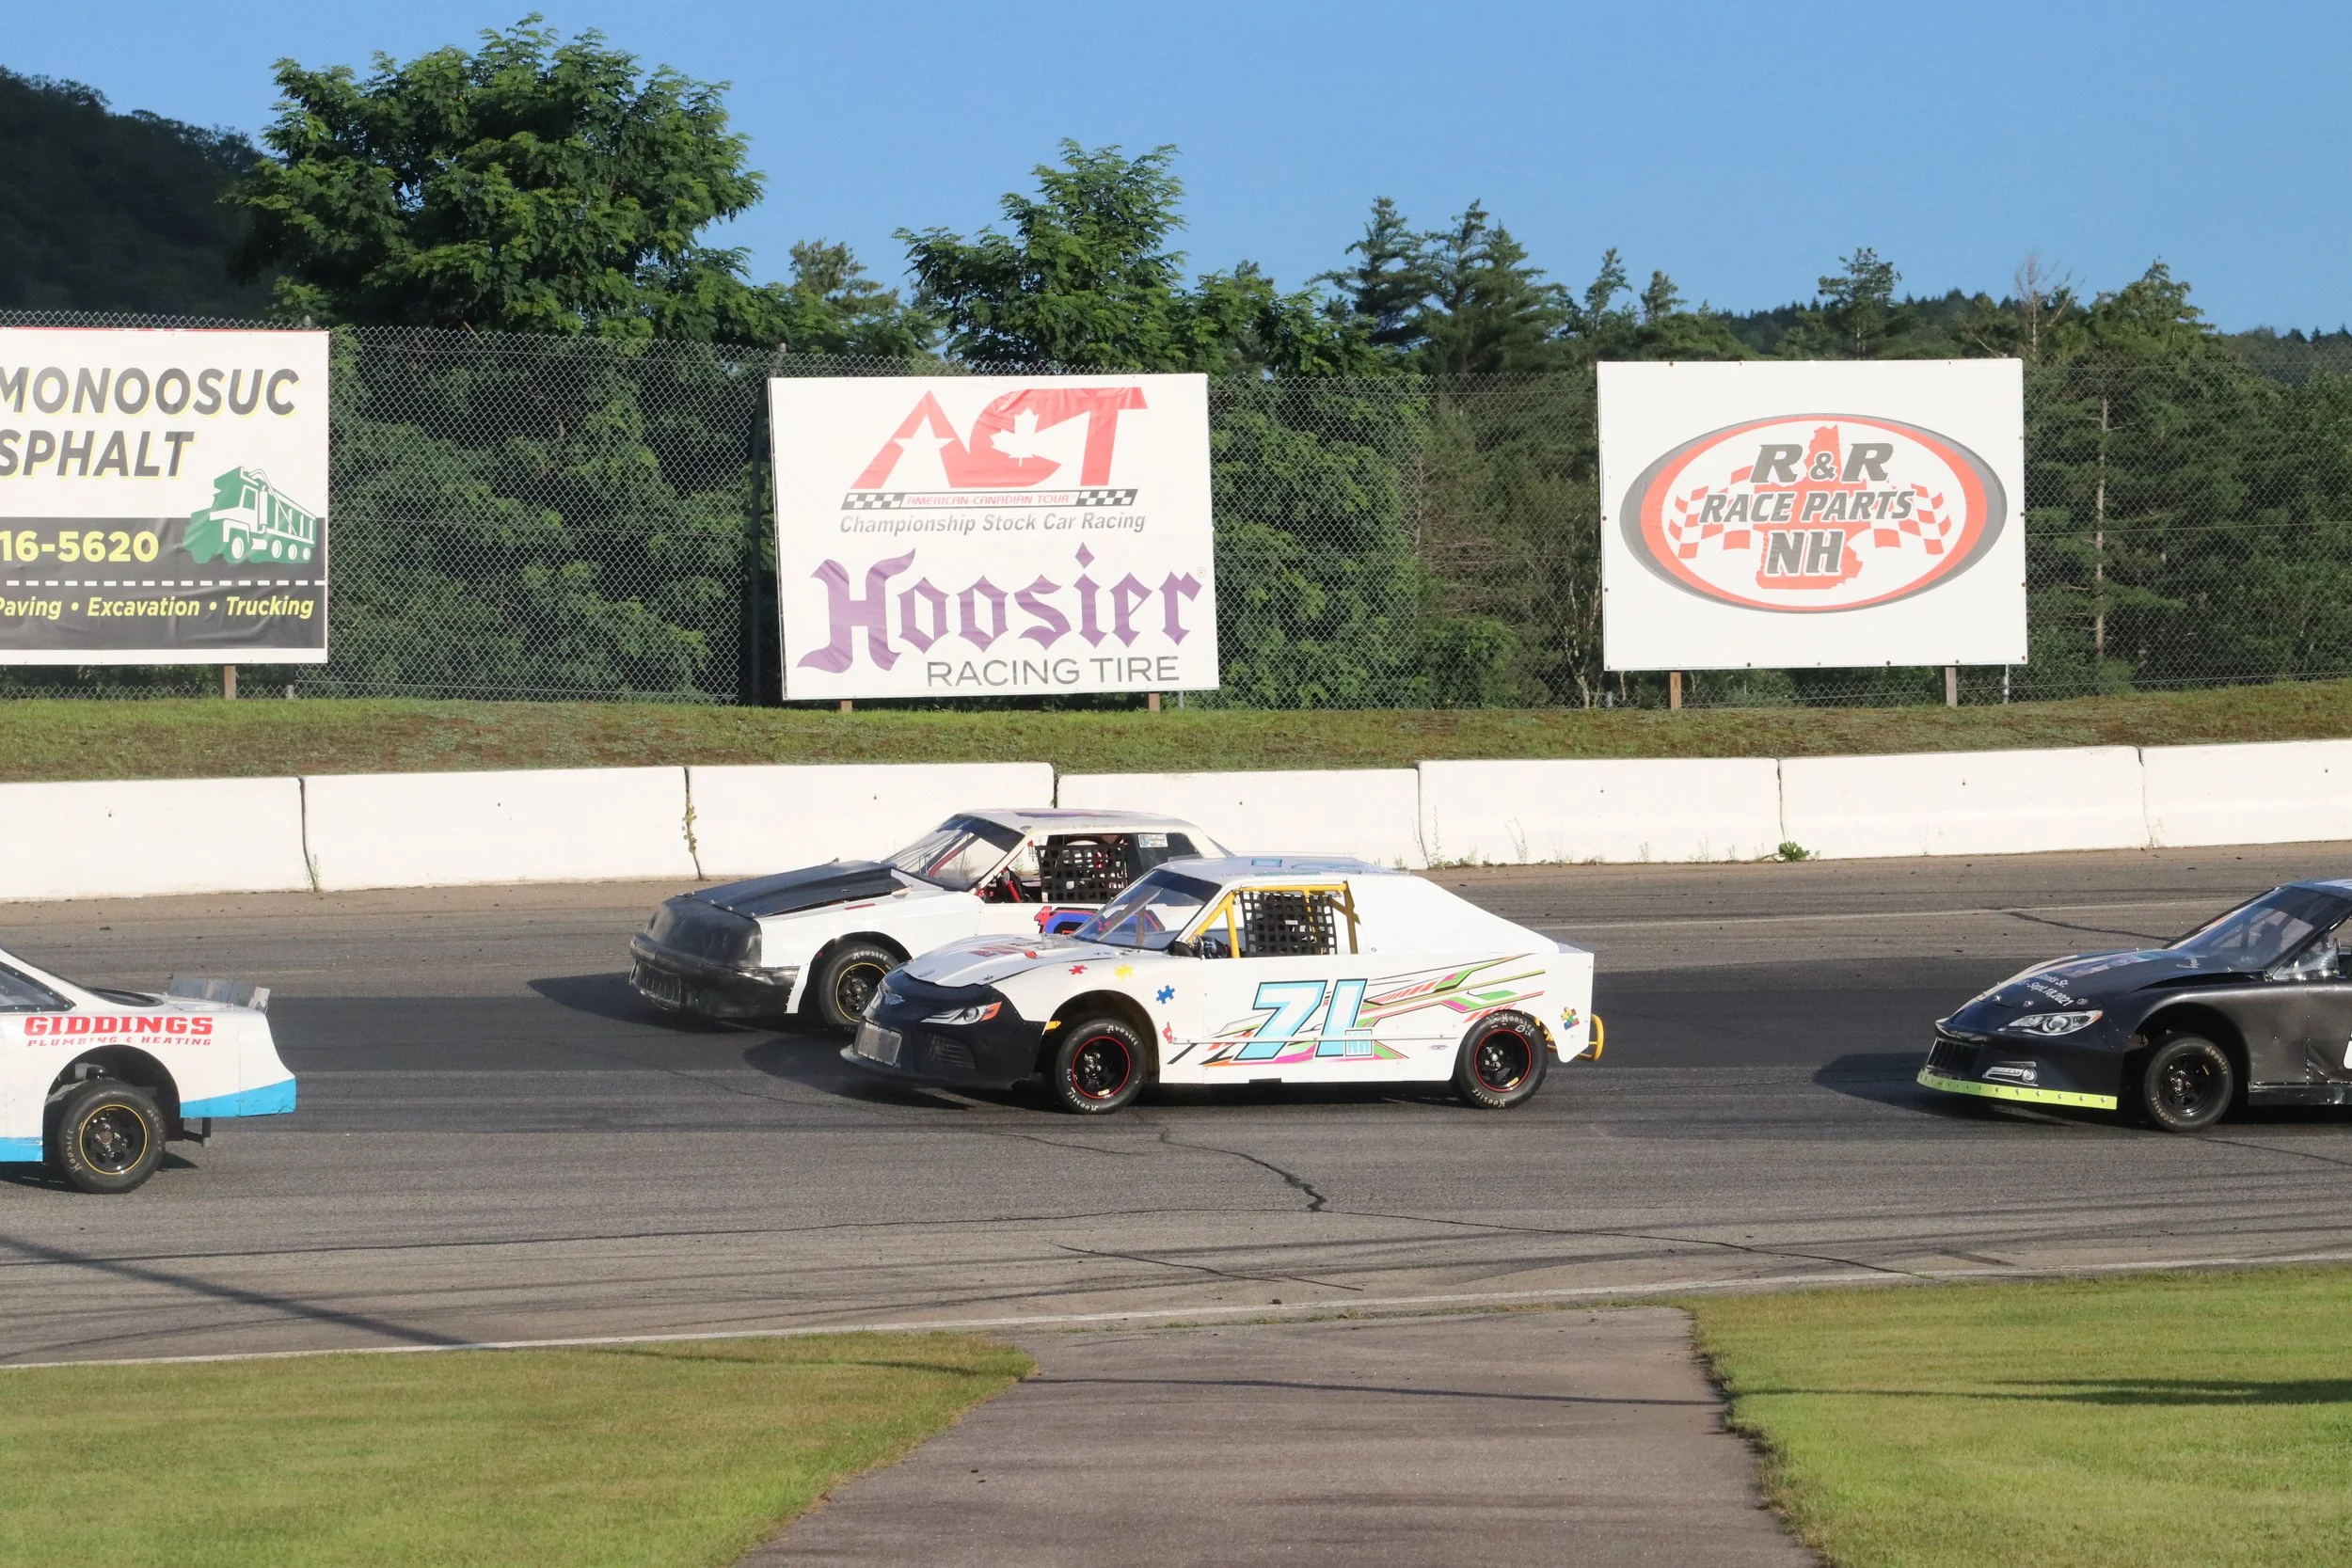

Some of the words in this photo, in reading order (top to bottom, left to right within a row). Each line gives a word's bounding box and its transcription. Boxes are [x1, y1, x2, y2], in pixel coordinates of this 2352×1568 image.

[0, 366, 300, 416] MONOOSUC
[0, 428, 196, 478] SPHALT
[850, 387, 1148, 489] ACT
[1749, 442, 1894, 483] R&R
[906, 494, 1034, 506] AMERICAN-CANADIAN
[1037, 494, 1070, 504] TOUR
[1699, 491, 1795, 523] RACE
[1801, 489, 1915, 522] PARTS
[840, 514, 976, 536] Championship
[982, 513, 1036, 531] Stock
[1043, 513, 1076, 530] Car
[1081, 511, 1146, 532] Racing
[0, 531, 160, 562] 16-5620
[1764, 530, 1844, 575] NH
[87, 596, 199, 617] Excavation
[226, 595, 315, 620] Trucking
[796, 542, 1202, 673] Hoosier
[927, 658, 1080, 688] RACING
[1089, 656, 1180, 684] TIRE
[24, 1016, 214, 1037] GIDDINGS
[1232, 978, 1368, 1061] 71
[26, 1037, 119, 1047] PLUMBING
[140, 1037, 212, 1046] HEATING
